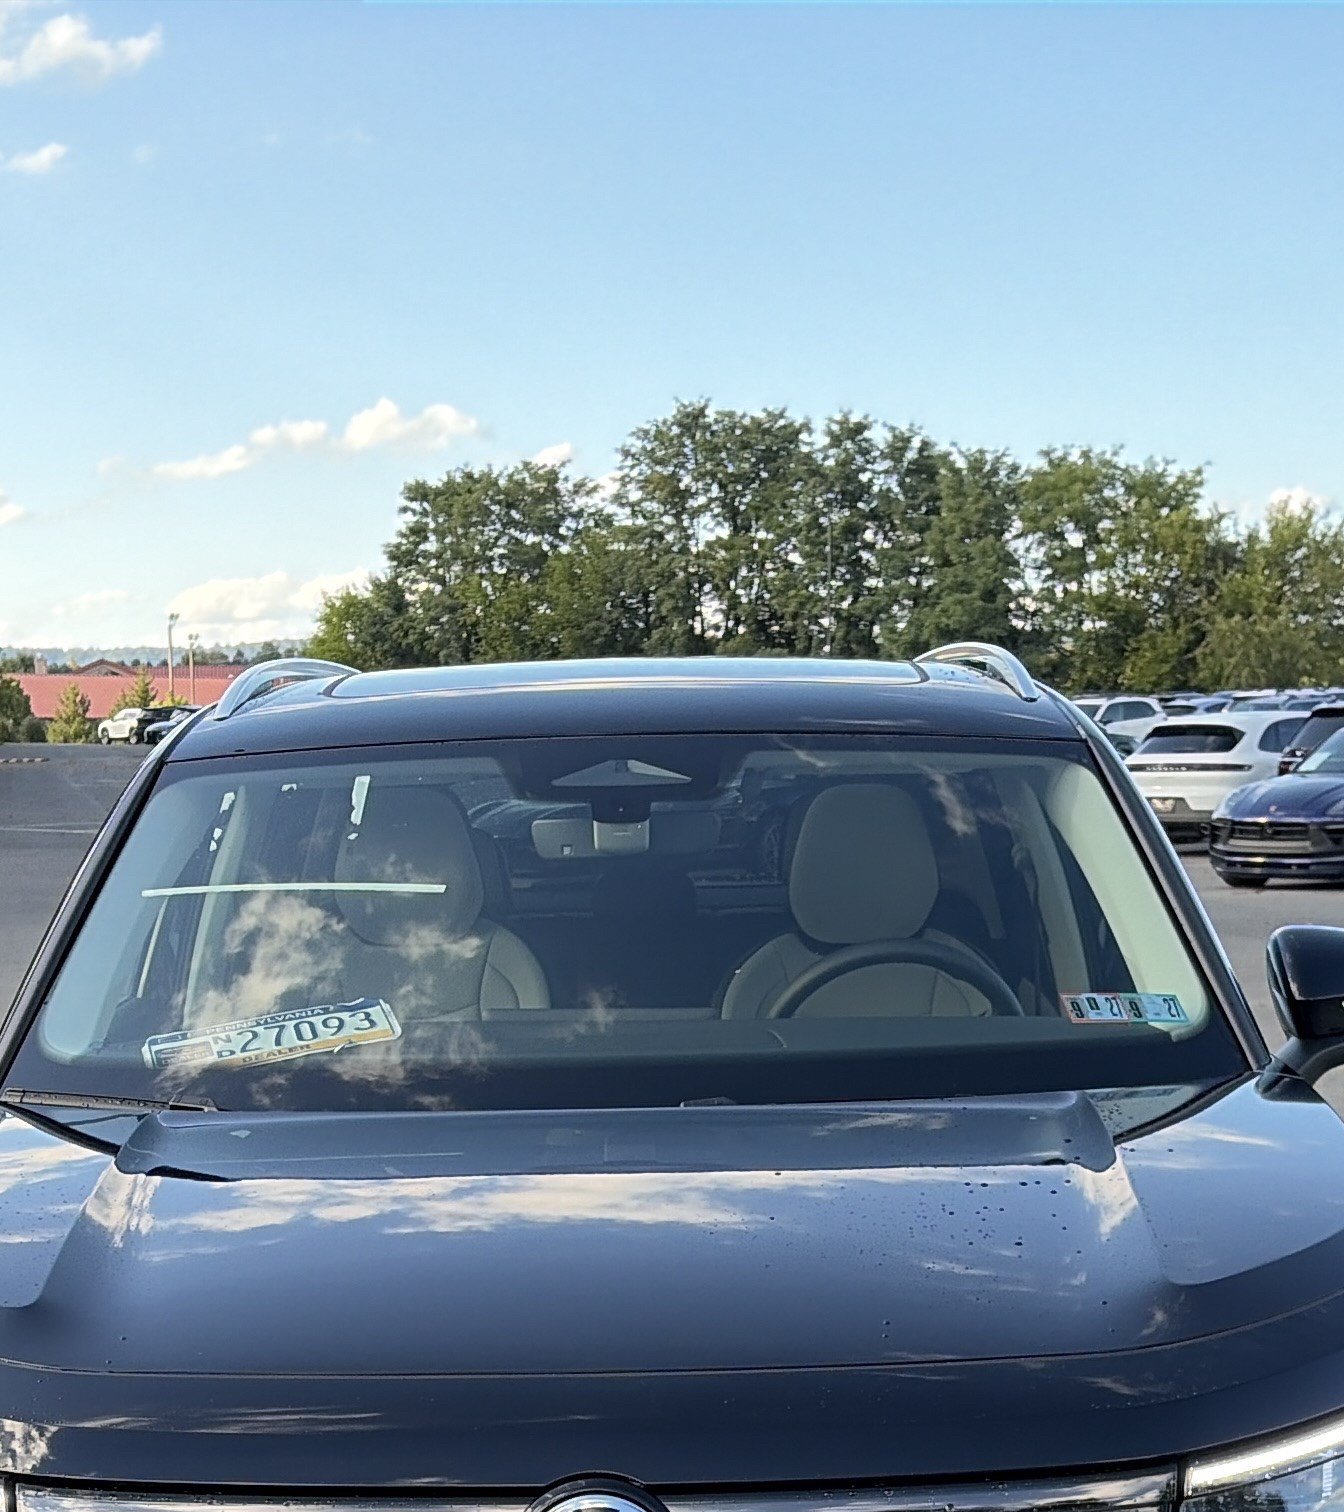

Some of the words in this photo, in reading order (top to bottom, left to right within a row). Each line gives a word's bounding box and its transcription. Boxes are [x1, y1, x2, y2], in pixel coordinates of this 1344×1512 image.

[1162, 997, 1181, 1019] 27
[205, 1008, 325, 1035] PENNSYLVANIA
[236, 1010, 378, 1054] 27093
[241, 1043, 312, 1064] DEALER
